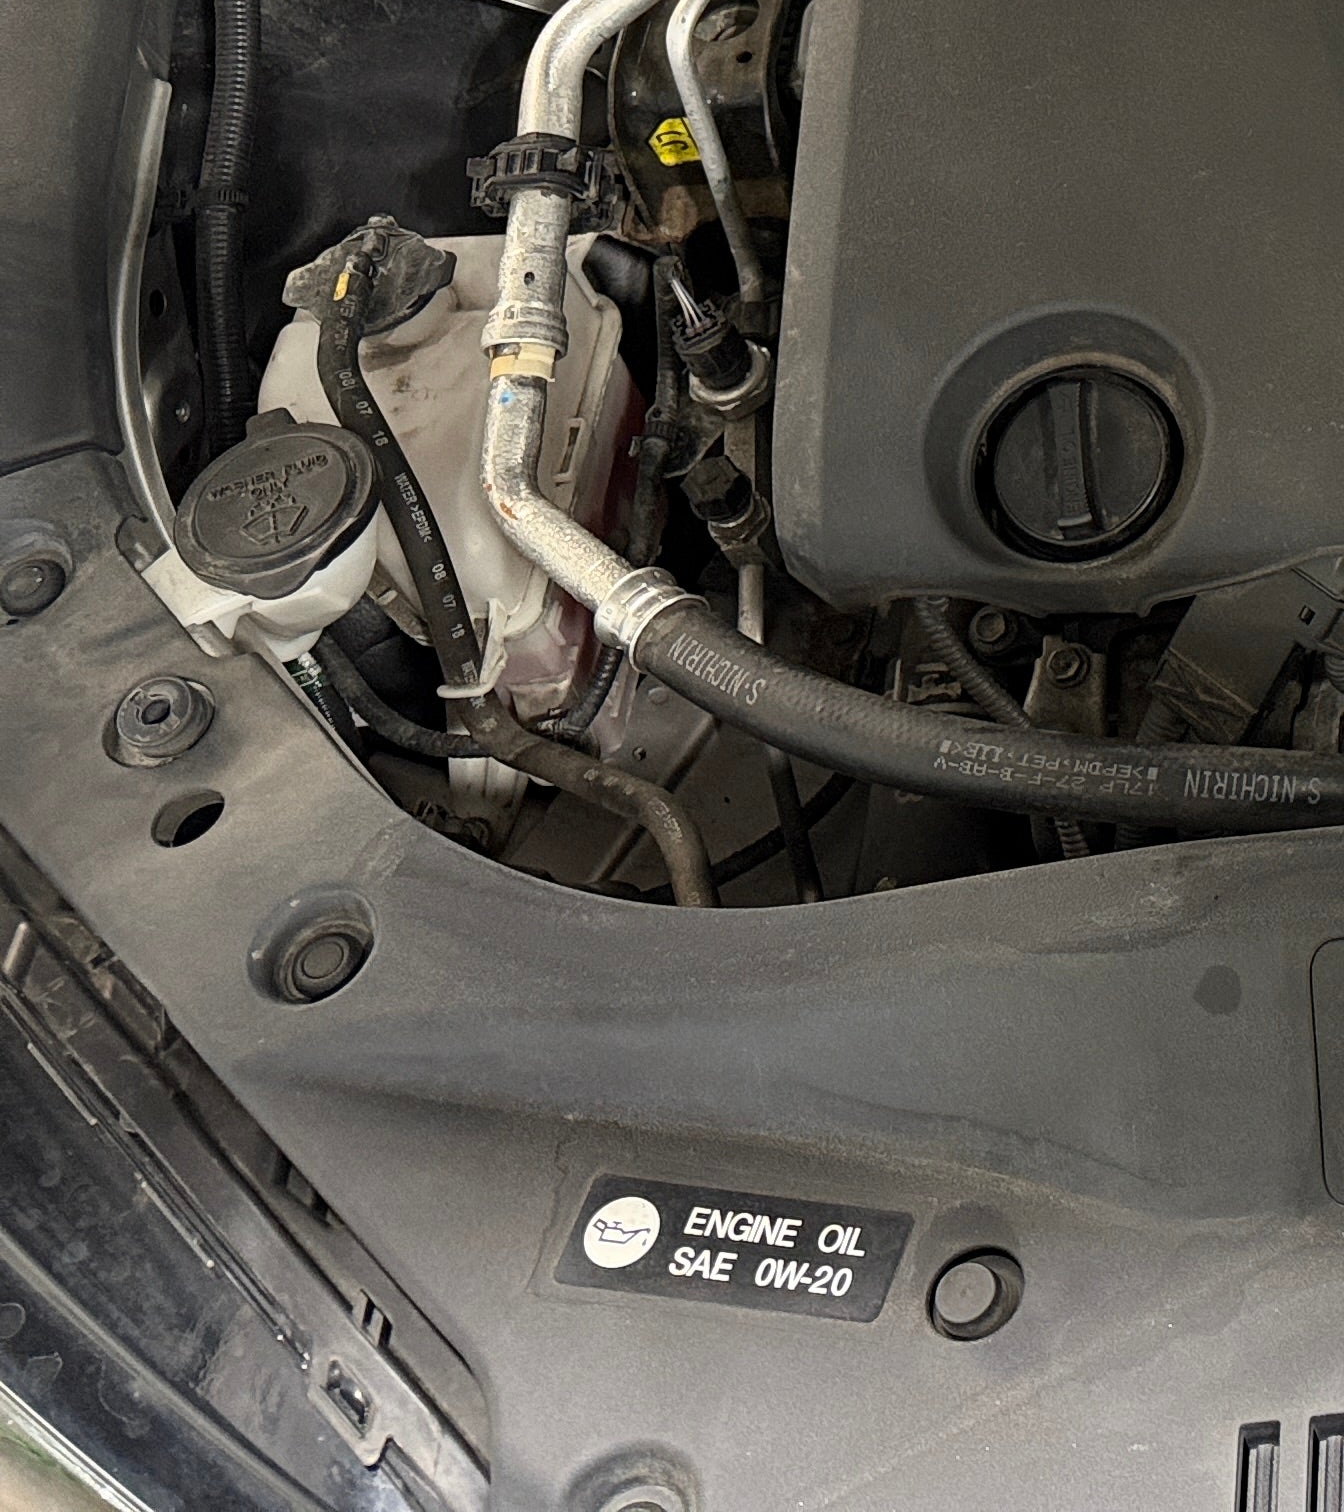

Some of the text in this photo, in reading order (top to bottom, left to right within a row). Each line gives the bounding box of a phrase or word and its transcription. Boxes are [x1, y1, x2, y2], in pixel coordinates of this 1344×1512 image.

[394, 472, 417, 505] WATER
[683, 1206, 866, 1257] ENGINE OIL
[668, 1246, 853, 1298] SAE 0W-20
